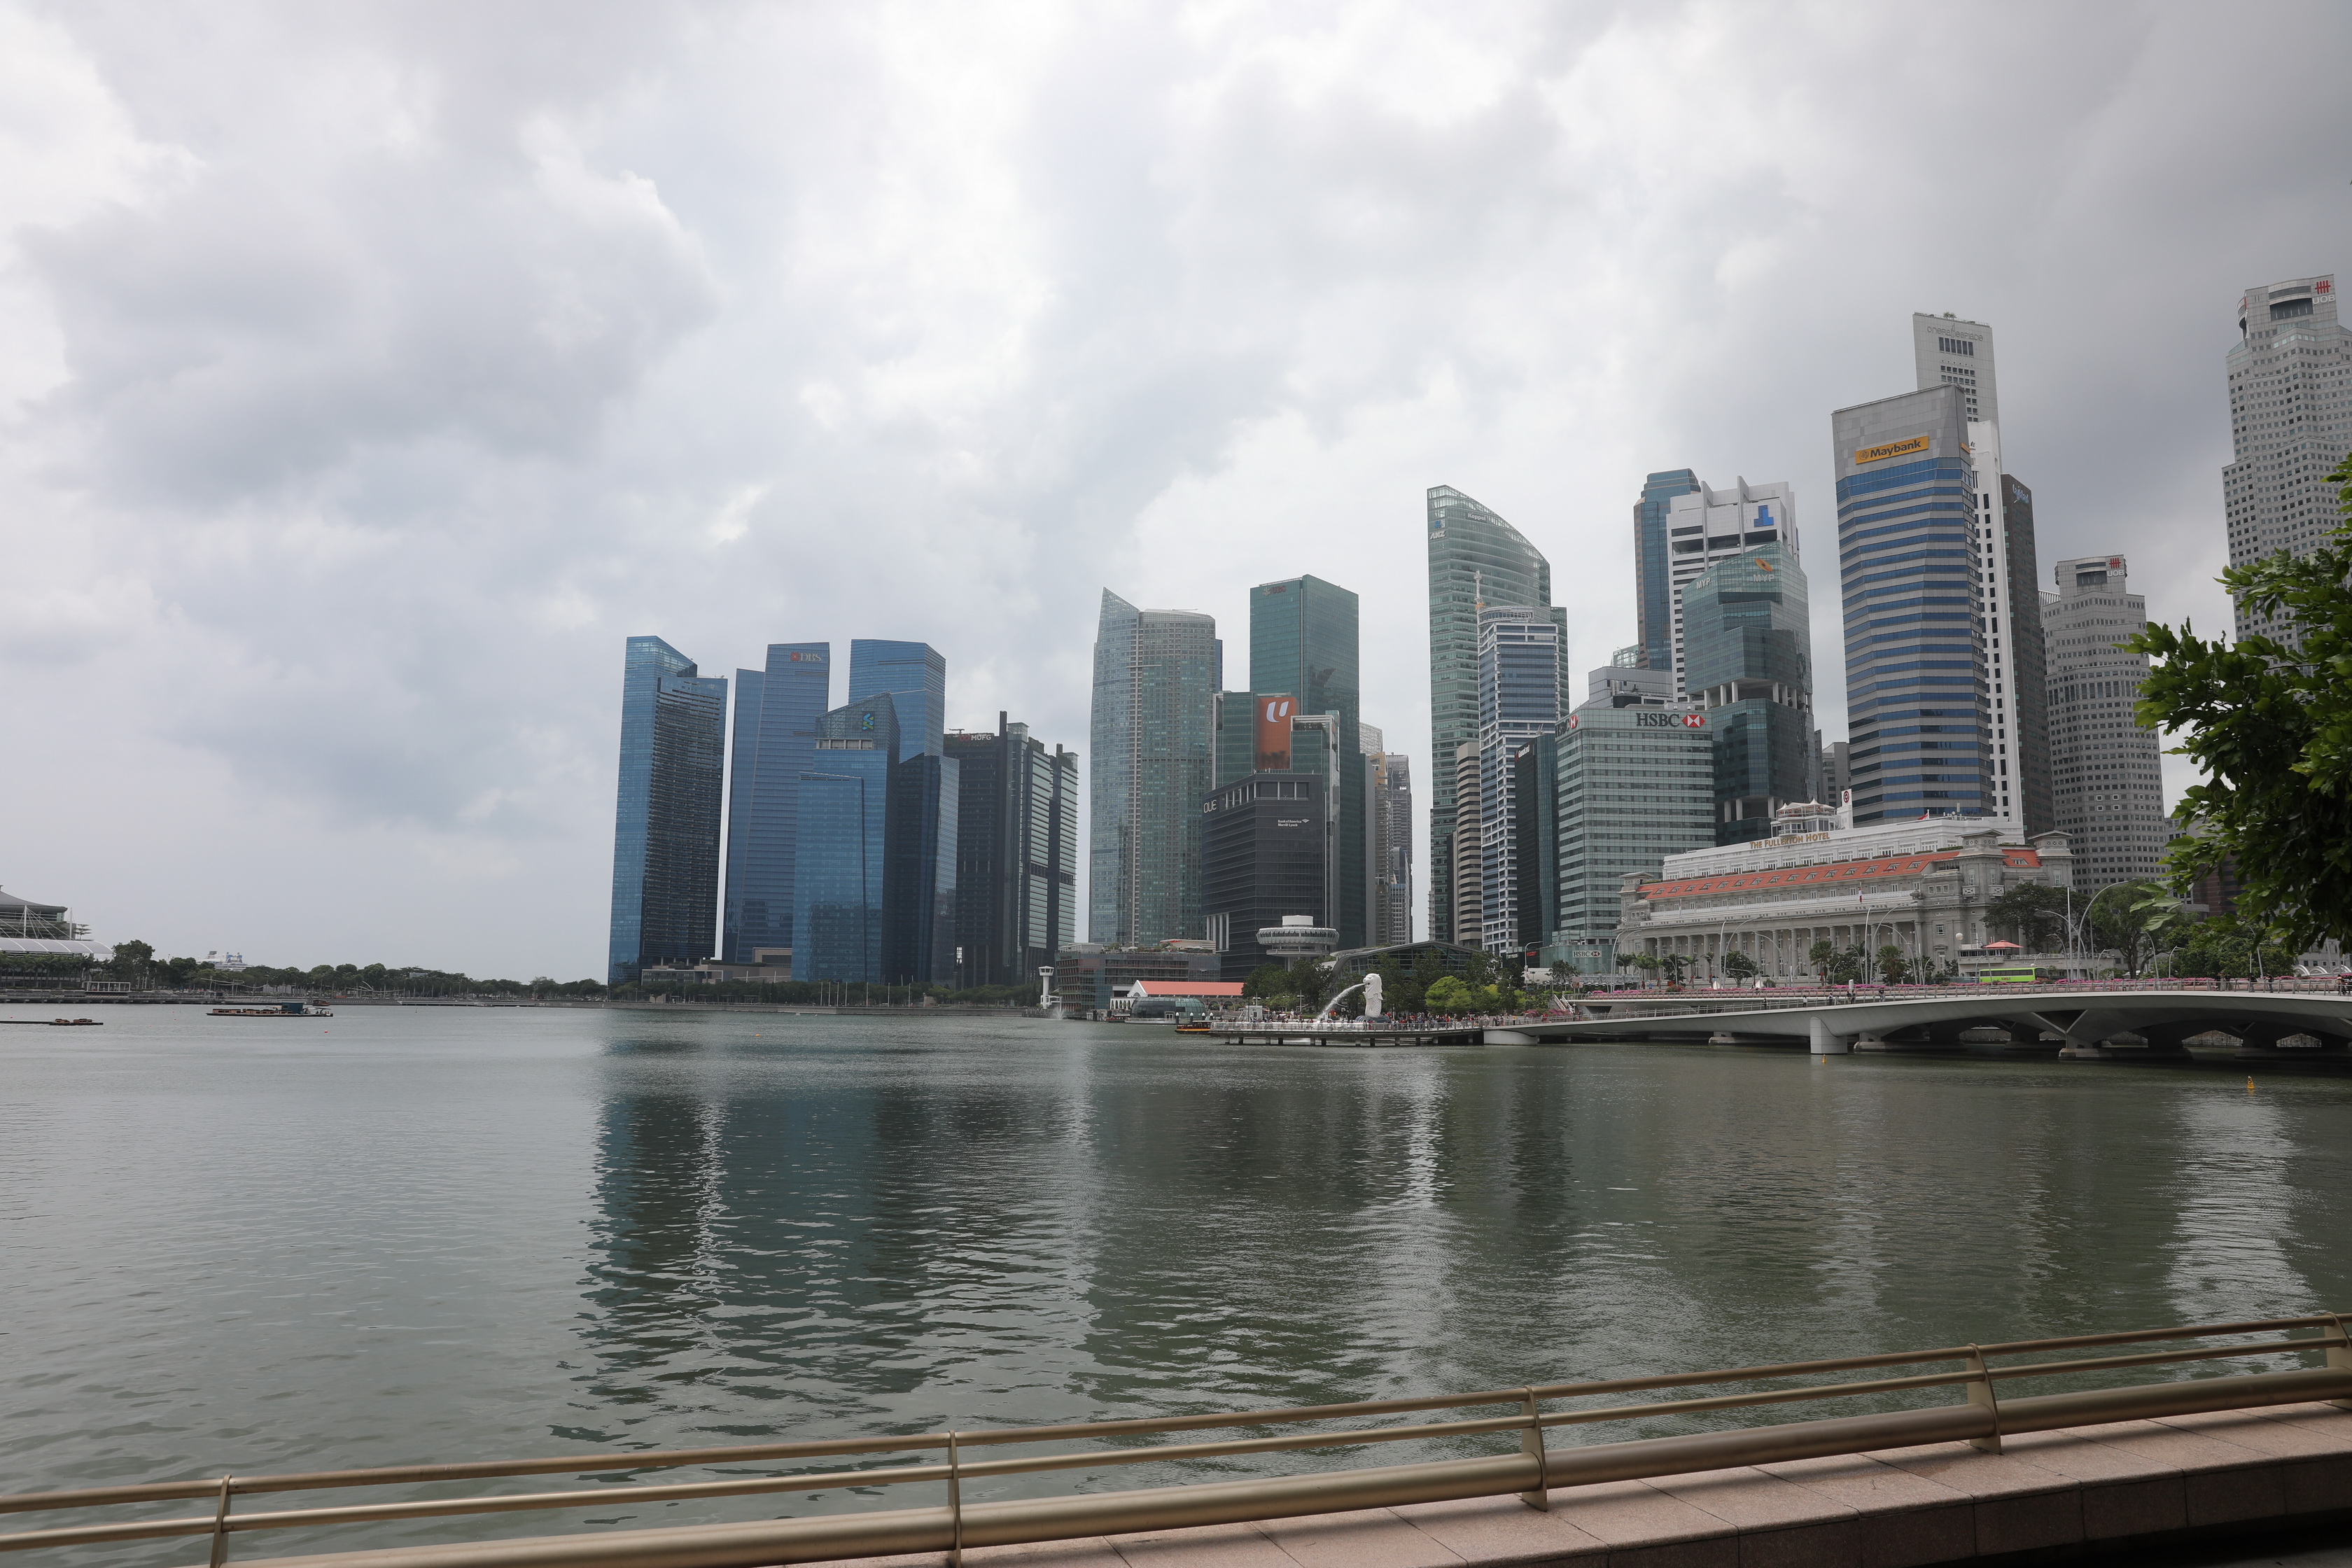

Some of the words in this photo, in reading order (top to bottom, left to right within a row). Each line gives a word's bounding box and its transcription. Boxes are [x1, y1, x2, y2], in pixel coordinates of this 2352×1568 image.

[2312, 295, 2335, 304] UOB
[1870, 440, 1921, 458] Maybank
[1468, 512, 1486, 521] Keppel
[1429, 530, 1446, 540] ANZ
[1697, 578, 1711, 589] MYP
[1753, 574, 1774, 582] MYP
[800, 652, 822, 662] DBS
[1636, 713, 1680, 727] HSBC
[1555, 718, 1570, 737] HSBC
[1203, 799, 1217, 813] OUE
[1749, 841, 1762, 849] THE
[1765, 836, 1803, 847] FULLERTON
[1806, 832, 1830, 842] HOTEL
